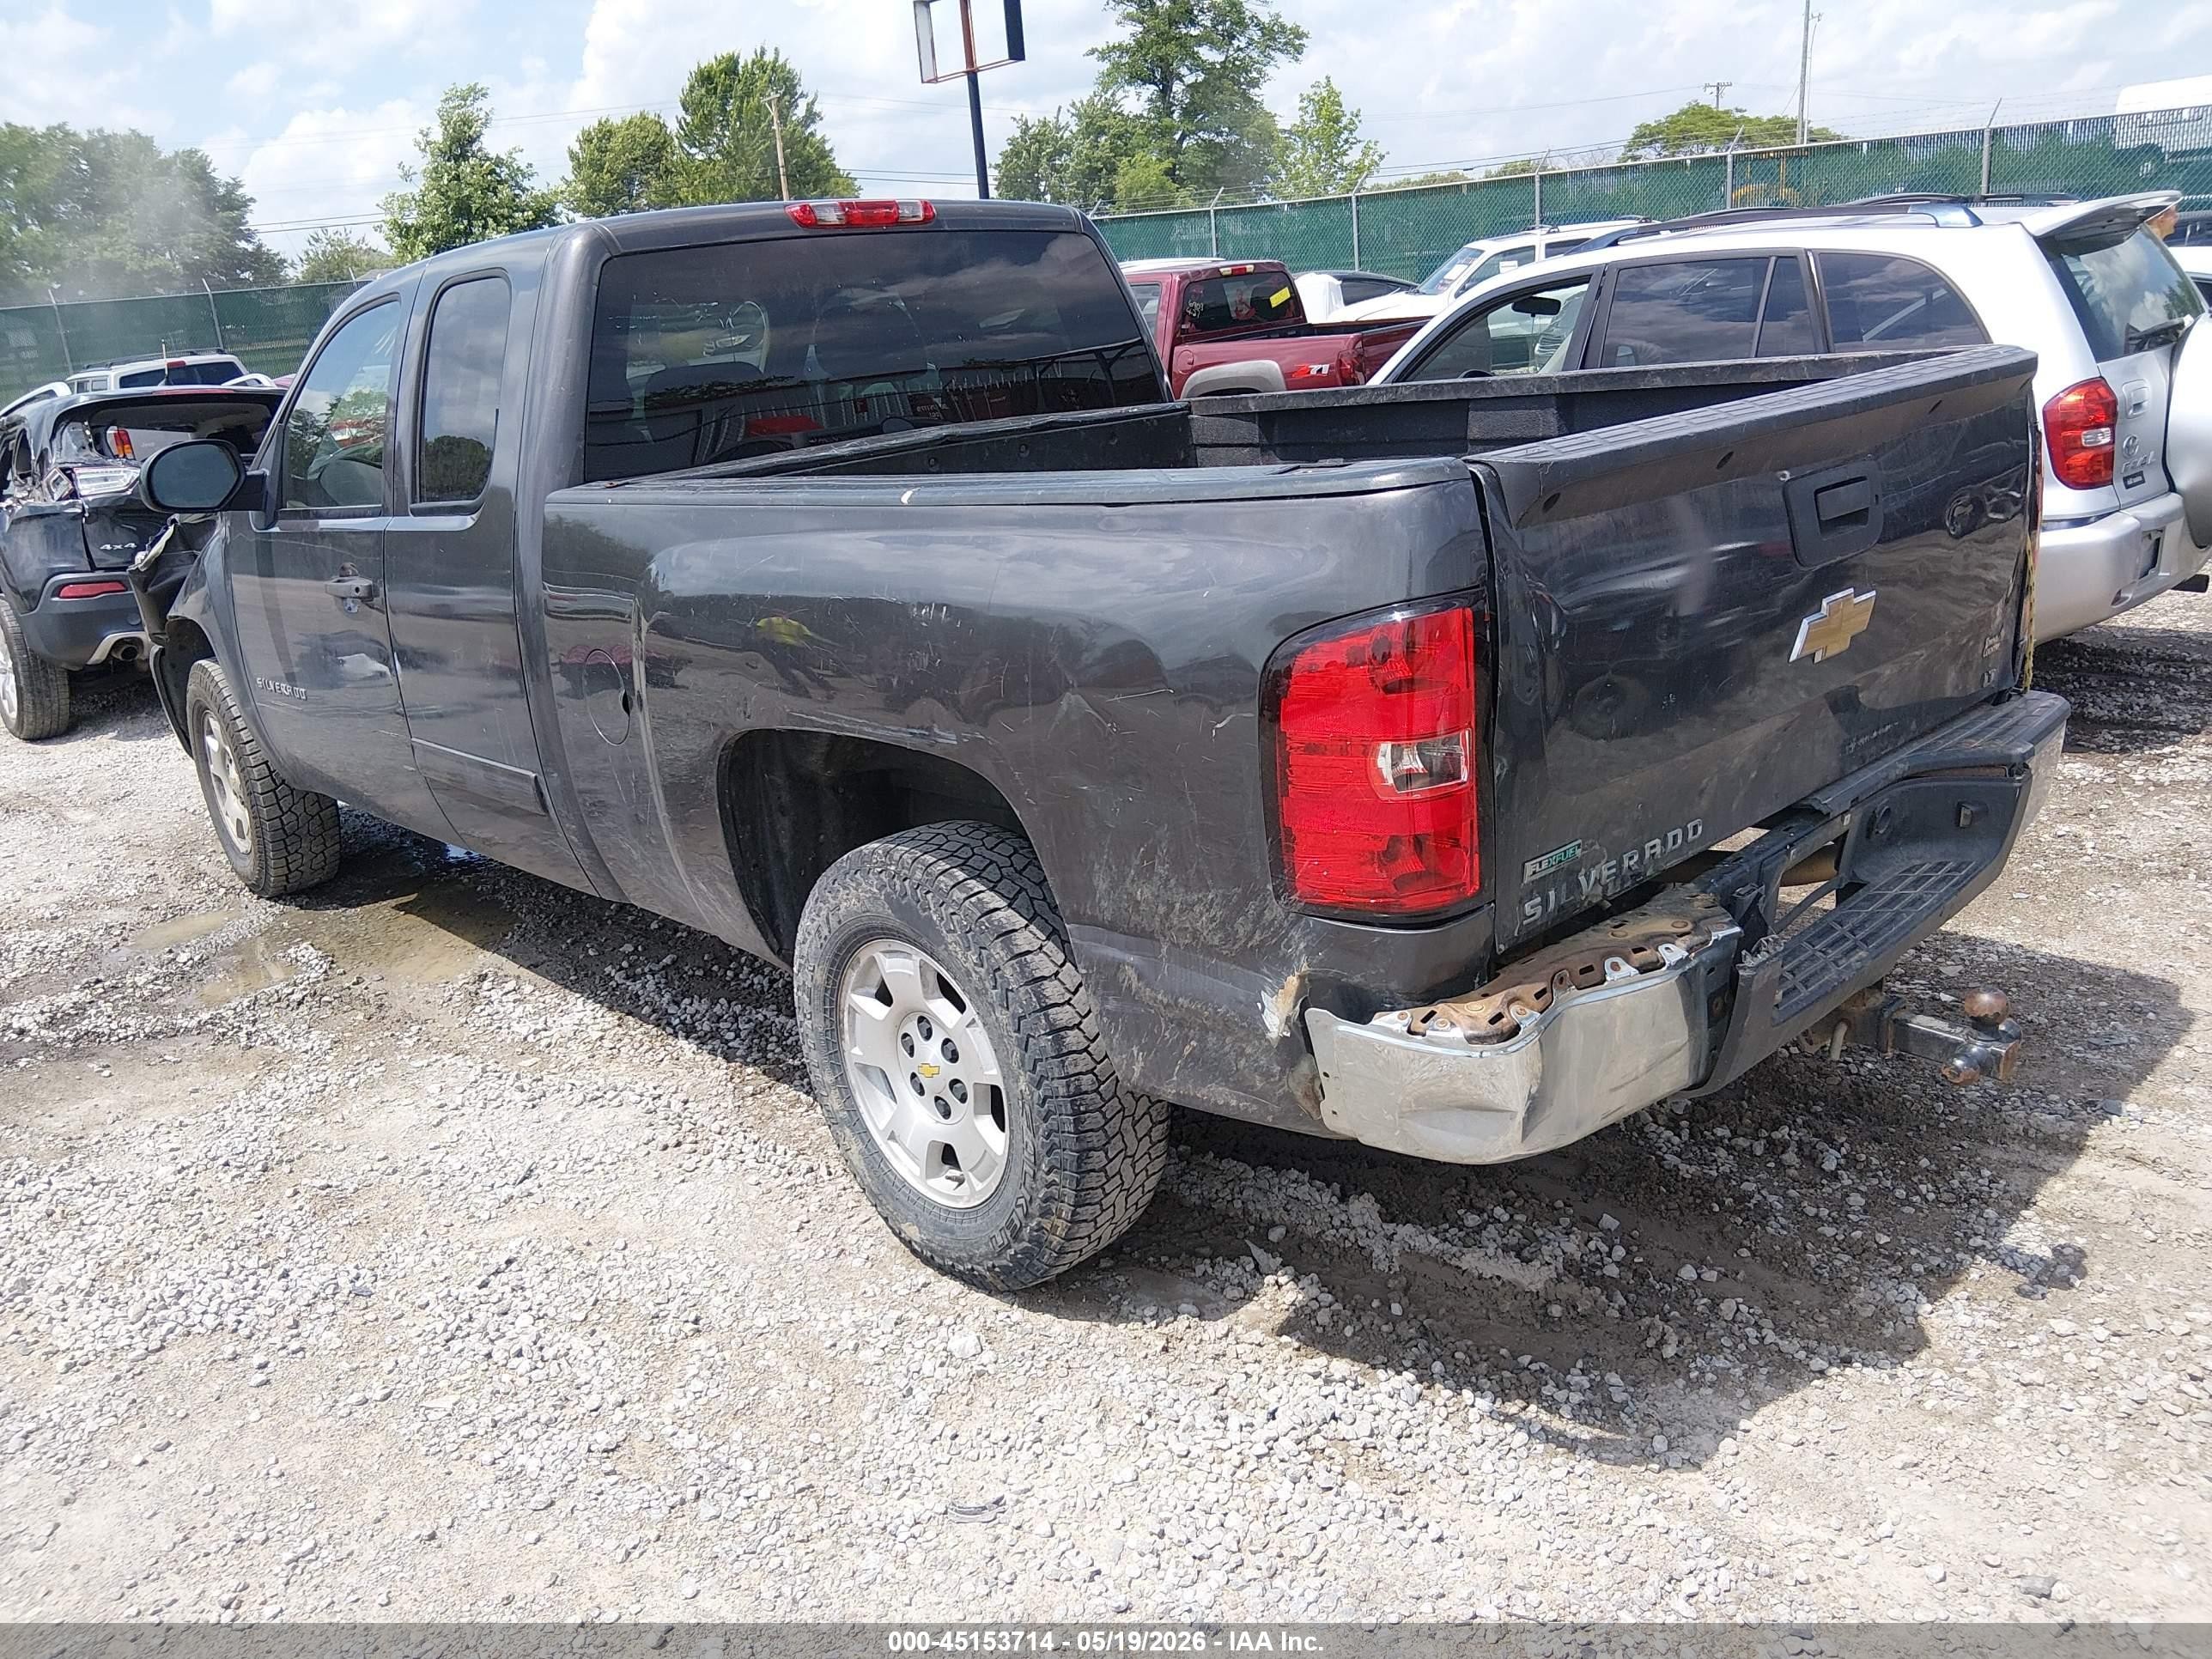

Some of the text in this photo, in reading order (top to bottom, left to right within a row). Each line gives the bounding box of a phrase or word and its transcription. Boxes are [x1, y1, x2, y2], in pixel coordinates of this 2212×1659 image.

[1291, 363, 1330, 378] Z71
[100, 542, 137, 550] 4x4
[256, 677, 307, 701] SILVERADO
[1522, 818, 1703, 925] SILVERADO
[1529, 843, 1582, 877] FLEXFUEL
